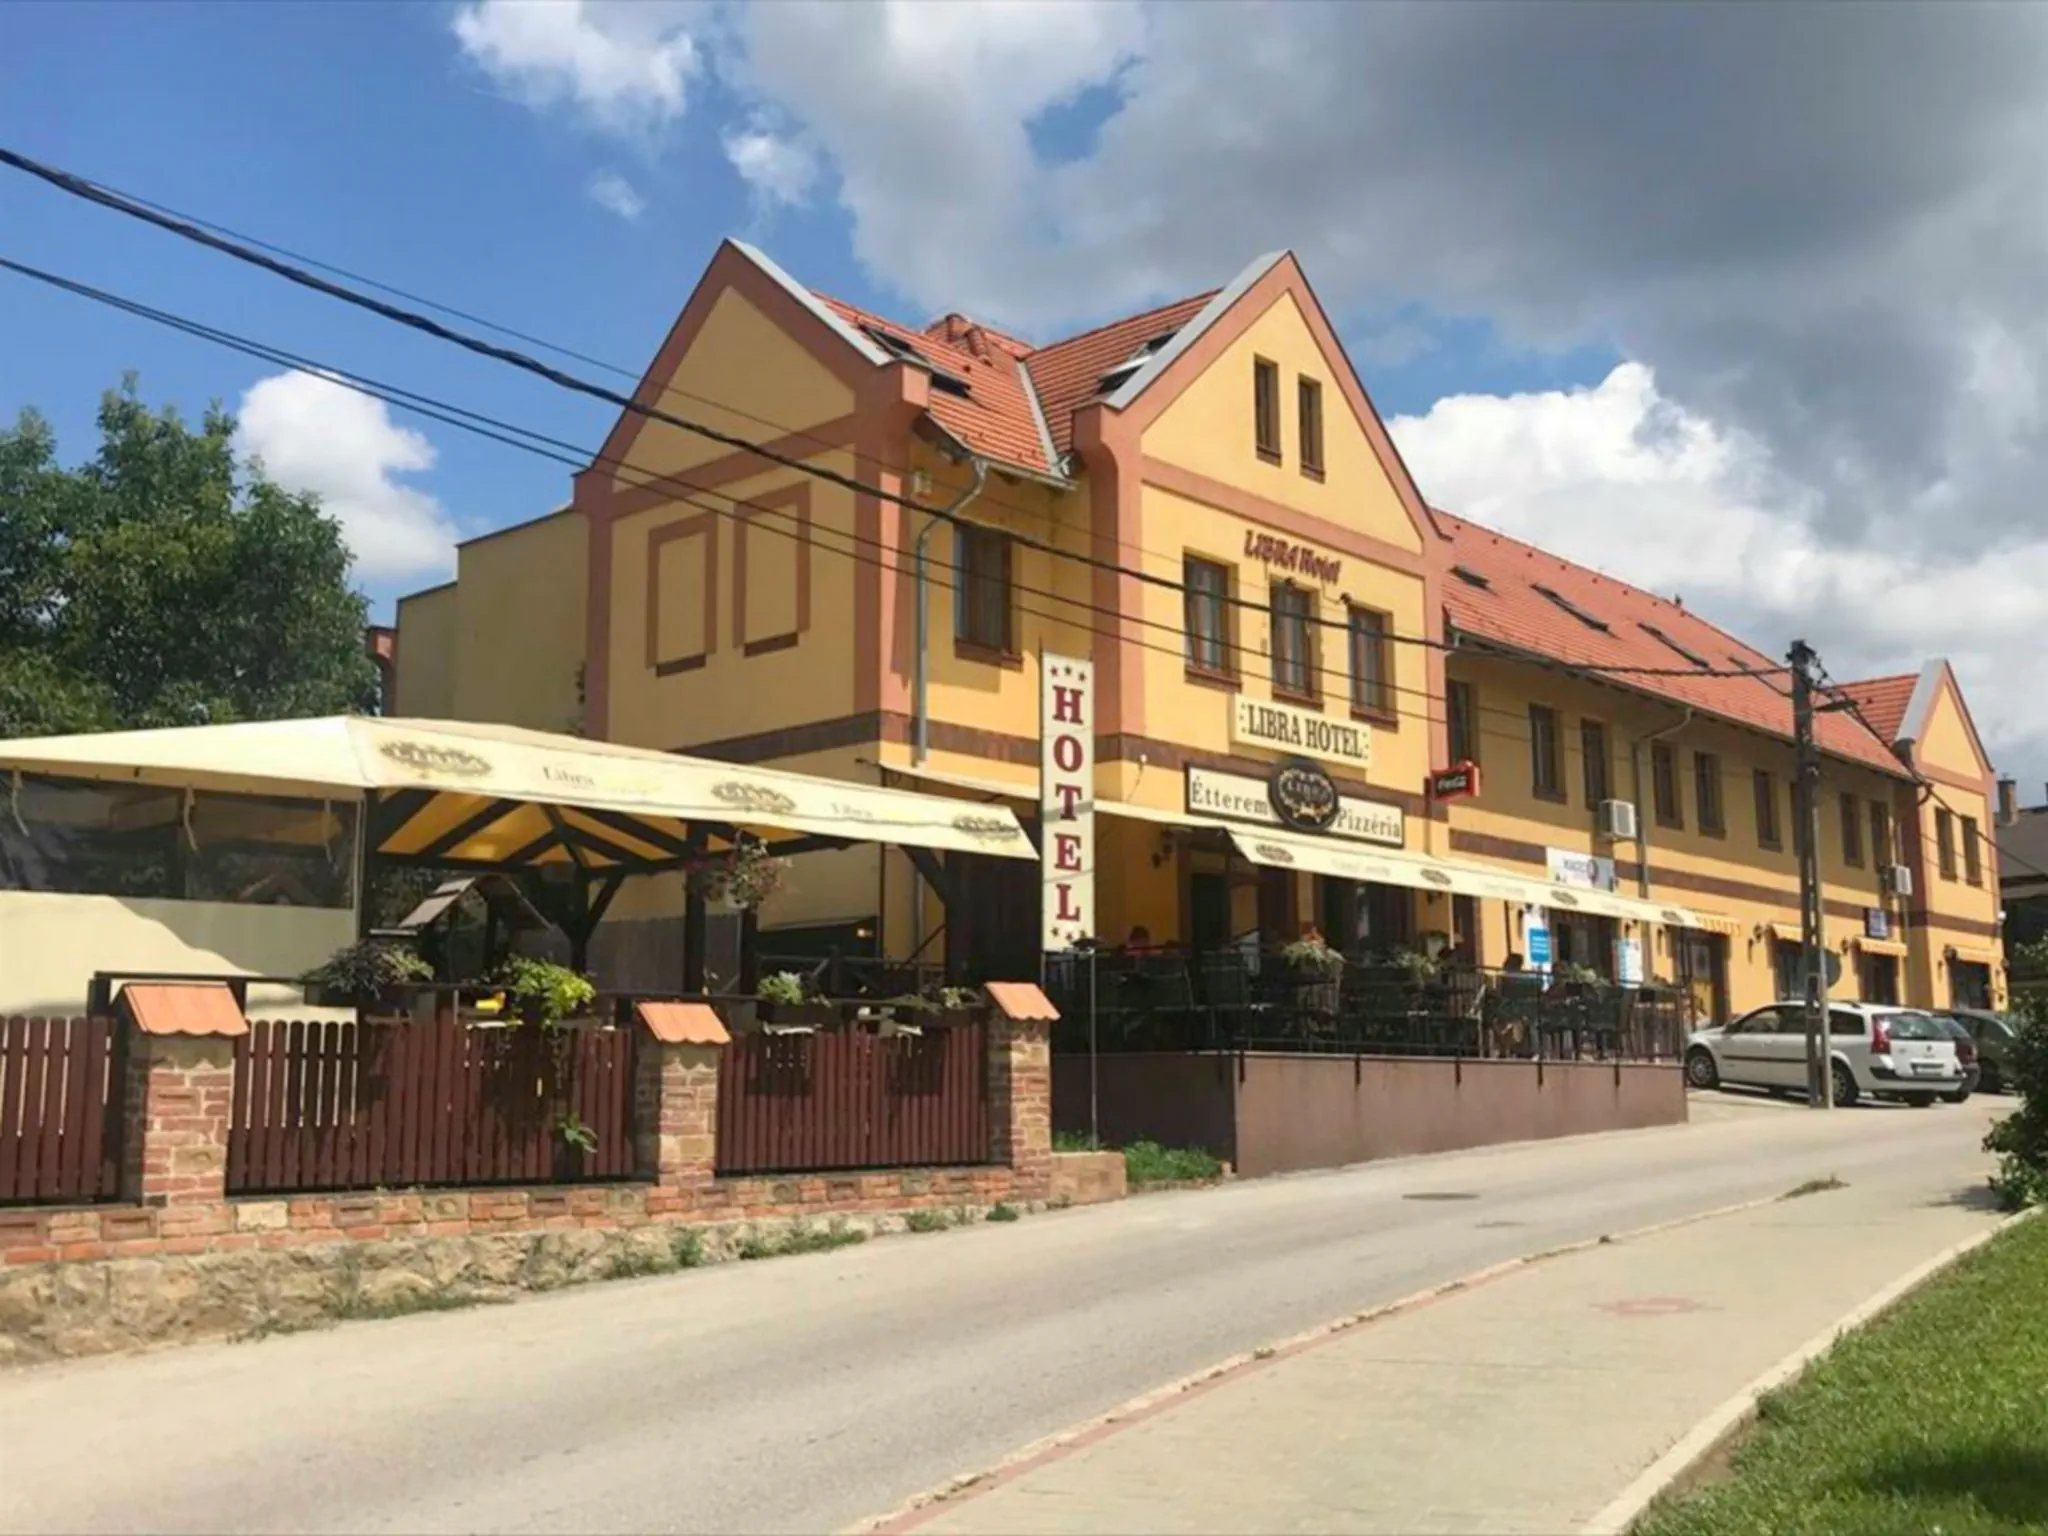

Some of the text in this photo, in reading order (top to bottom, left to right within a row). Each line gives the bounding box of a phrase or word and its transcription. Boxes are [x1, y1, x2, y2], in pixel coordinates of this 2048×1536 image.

[1247, 703, 1364, 759] LIBRA HOTEL
[1052, 684, 1084, 922] HOTEL
[1191, 776, 1269, 816] Étterem
[1336, 806, 1401, 838] Pizzéria
